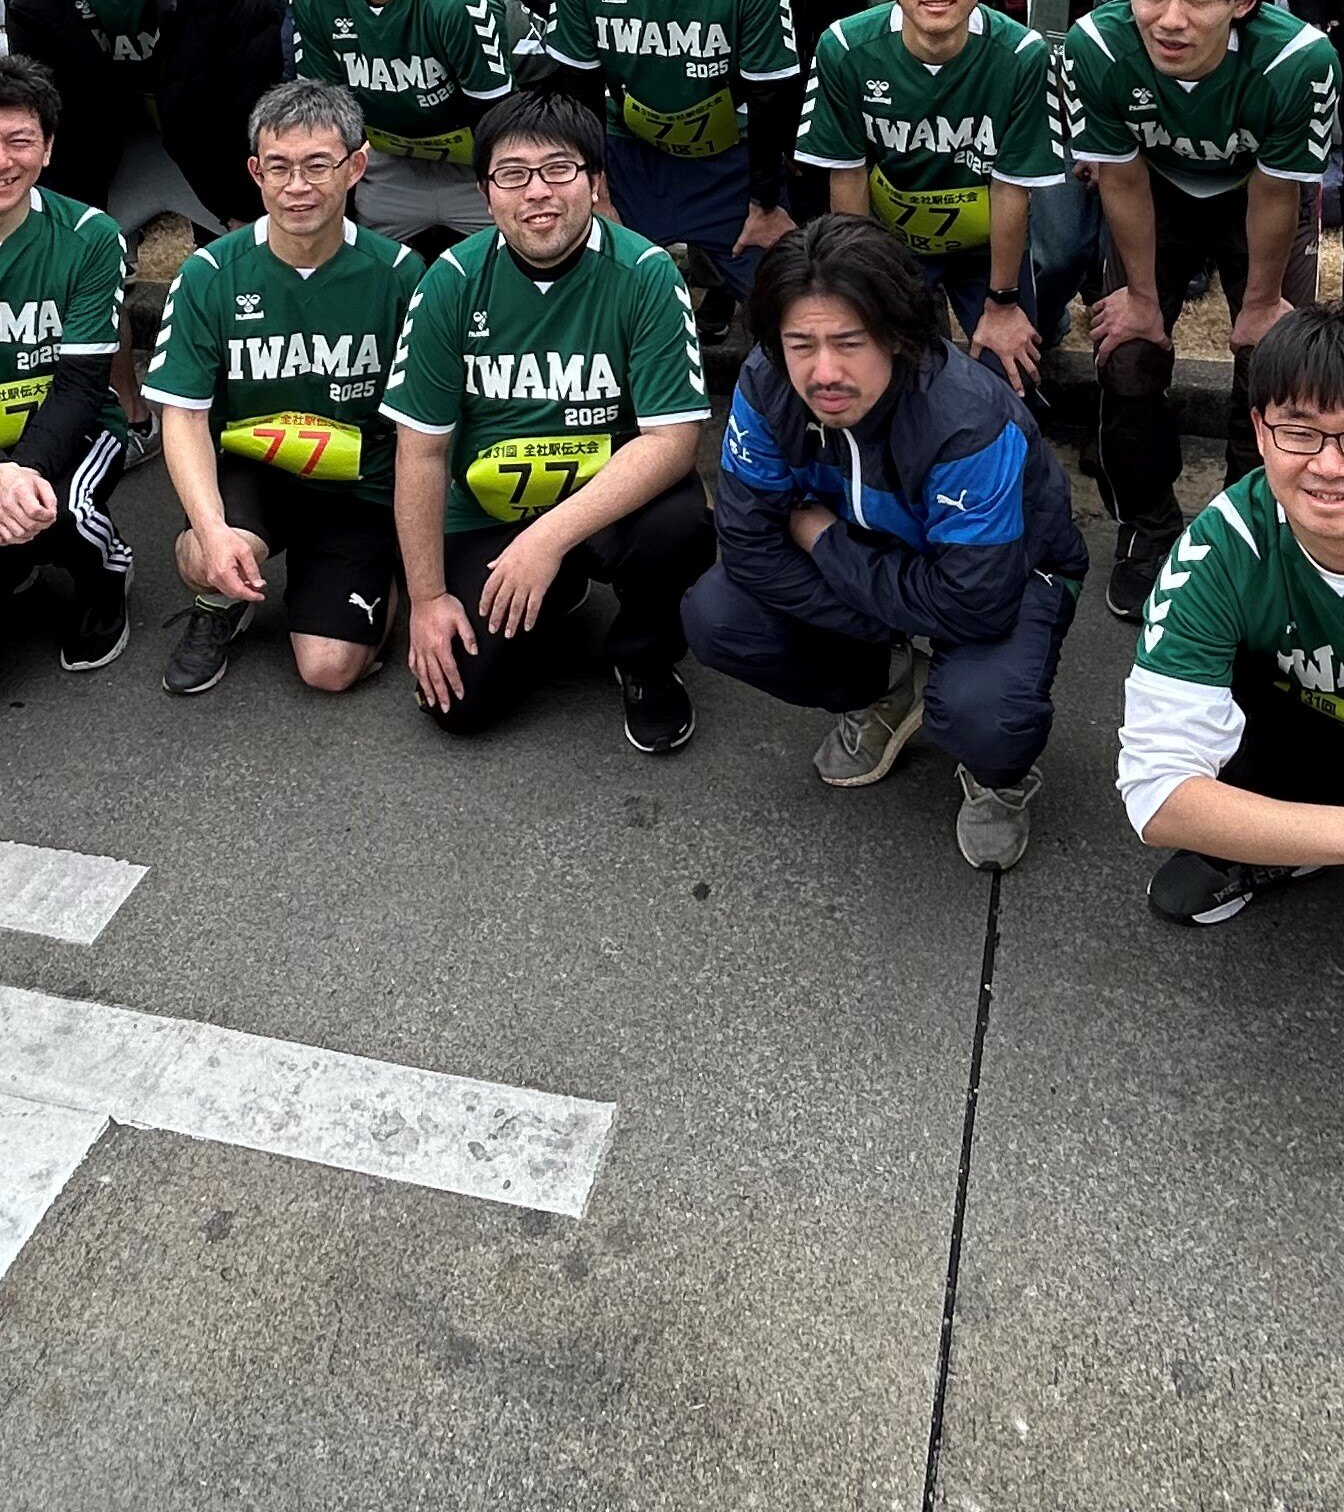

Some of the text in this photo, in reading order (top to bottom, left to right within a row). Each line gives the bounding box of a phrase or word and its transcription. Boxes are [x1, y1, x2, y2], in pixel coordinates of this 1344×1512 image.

[595, 15, 732, 58] IWAMA
[333, 49, 449, 93] WAMA
[685, 59, 730, 79] 2025
[645, 111, 712, 144] 77
[861, 110, 998, 156] IWAMA
[953, 150, 995, 176] 2025
[888, 195, 961, 237] 77
[227, 332, 381, 380] IWAMA
[463, 351, 622, 402] IWAMA
[329, 378, 377, 402] 2025
[564, 404, 620, 427] 2025
[253, 427, 332, 477] 77
[523, 441, 600, 457] 全社駅伝大会
[498, 460, 580, 505] 77
